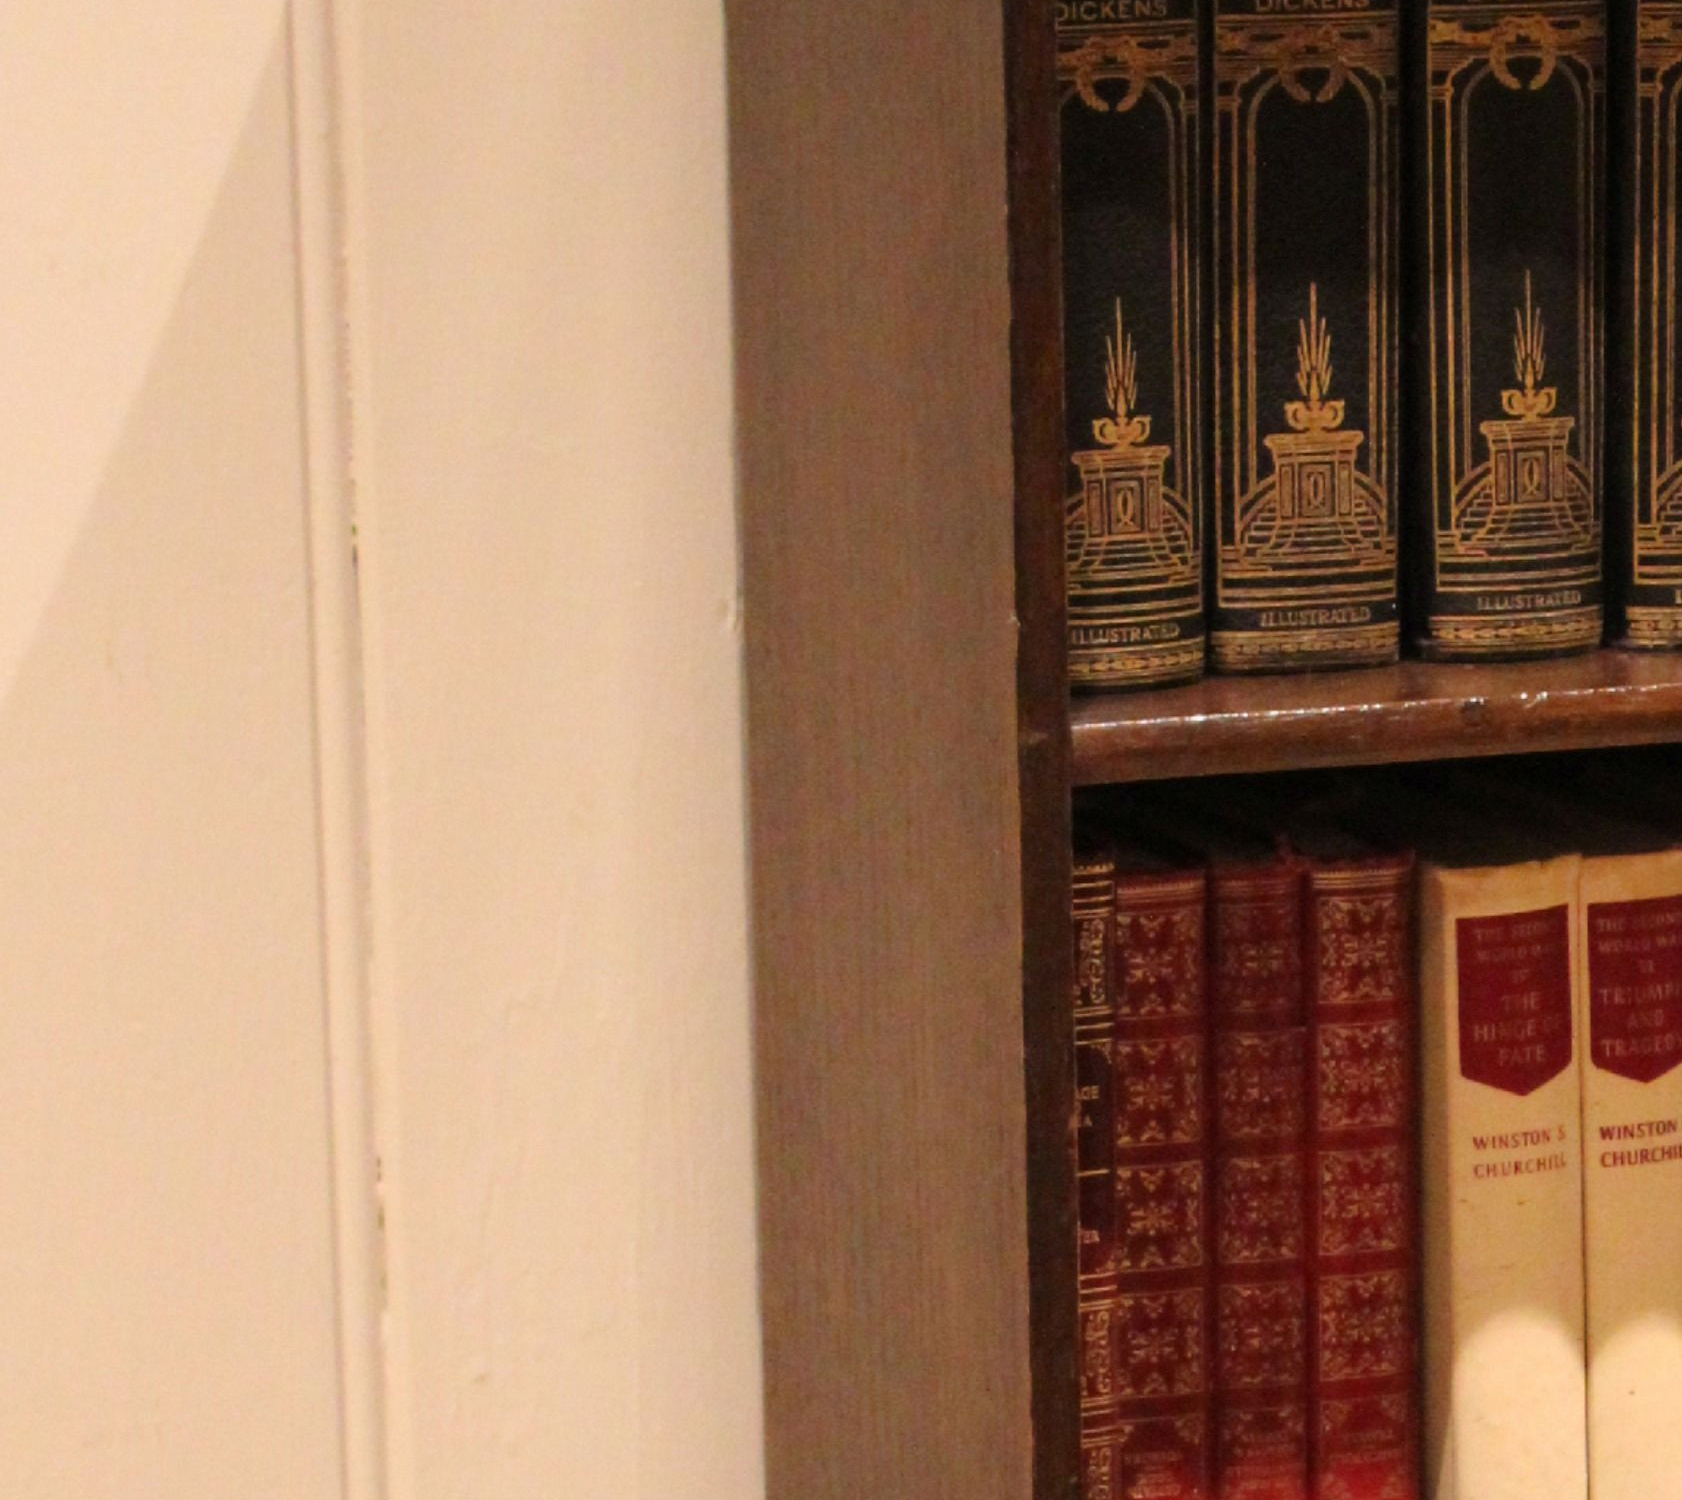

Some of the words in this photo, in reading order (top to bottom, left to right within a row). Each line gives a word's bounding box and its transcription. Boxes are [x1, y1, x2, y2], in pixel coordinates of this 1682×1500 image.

[1478, 589, 1582, 612] ILLUSTRATED
[1259, 605, 1372, 628] ILLUSTRATED
[1071, 622, 1180, 646] ILLUSTRATED
[1472, 1129, 1551, 1151] WINSTON
[1599, 1120, 1676, 1141] WINSTON
[1473, 1152, 1567, 1179] CHURCHILL
